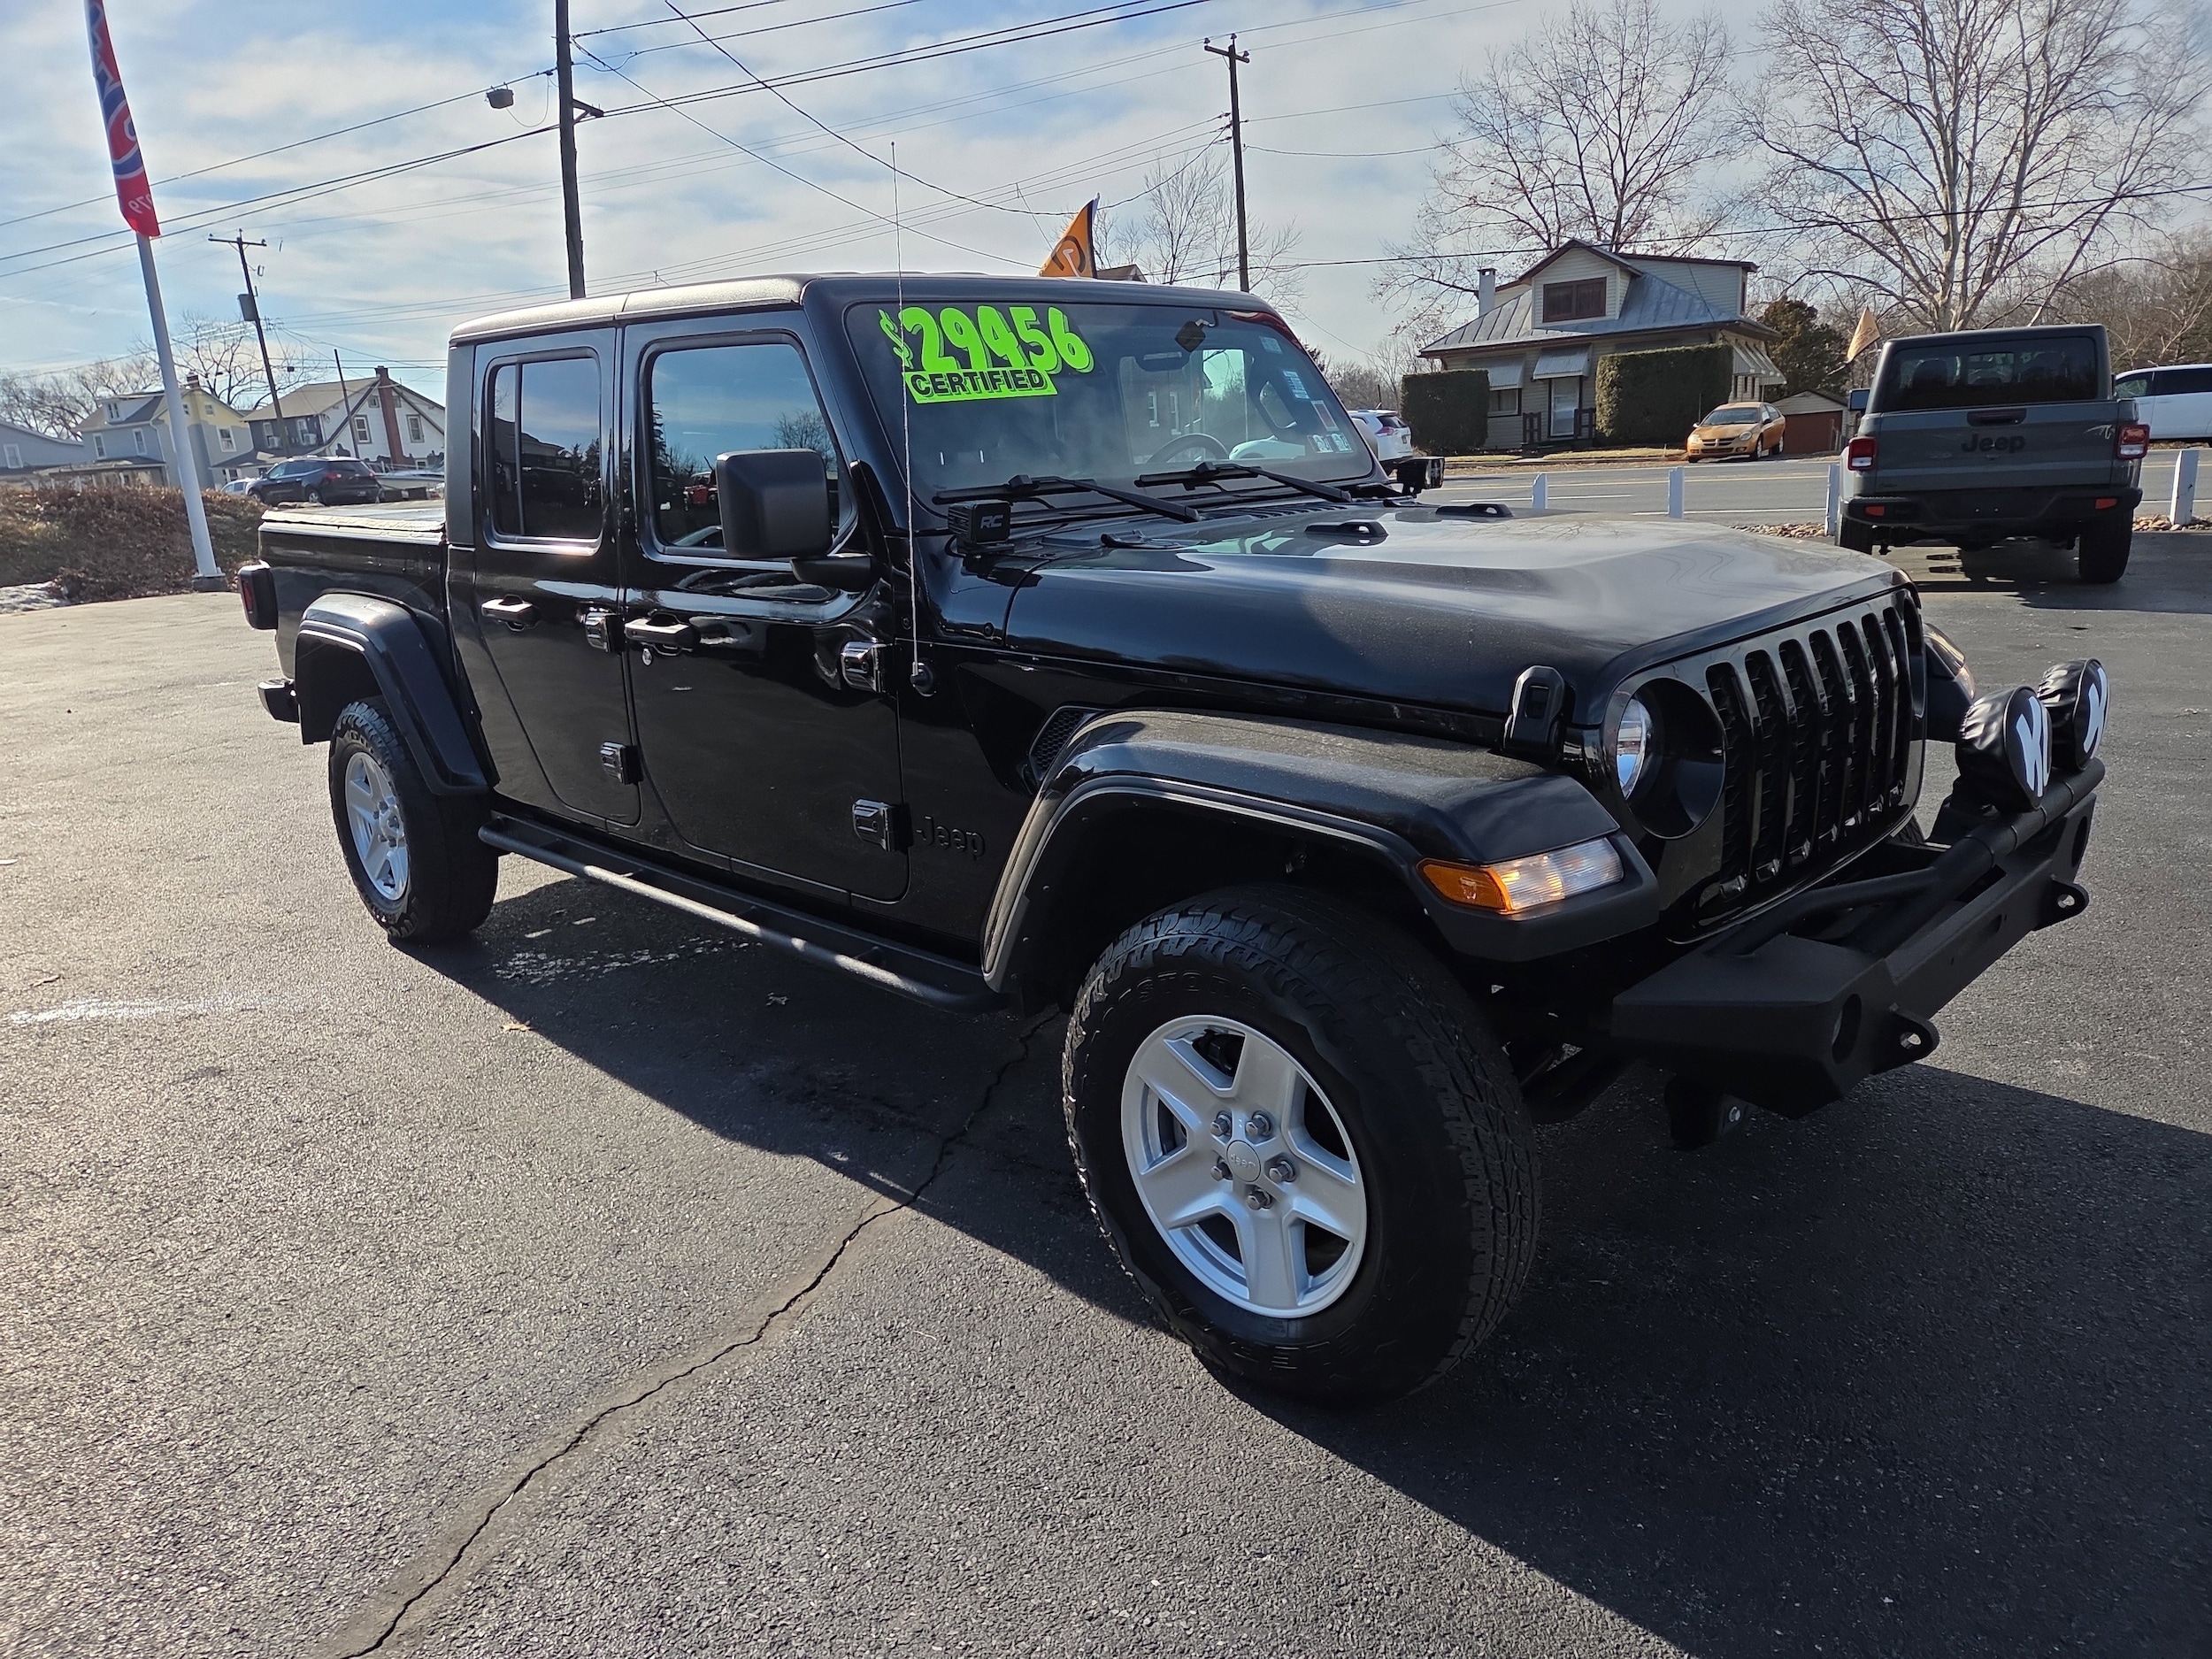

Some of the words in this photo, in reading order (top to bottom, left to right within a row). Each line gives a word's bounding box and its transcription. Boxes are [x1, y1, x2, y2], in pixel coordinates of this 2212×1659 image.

[877, 305, 1095, 375] $29456
[910, 369, 1049, 399] CERTIFIED
[1961, 432, 2026, 455] Jeep
[980, 514, 1004, 530] RC
[915, 814, 987, 862] Jeep
[1230, 1153, 1256, 1168] Jeep
